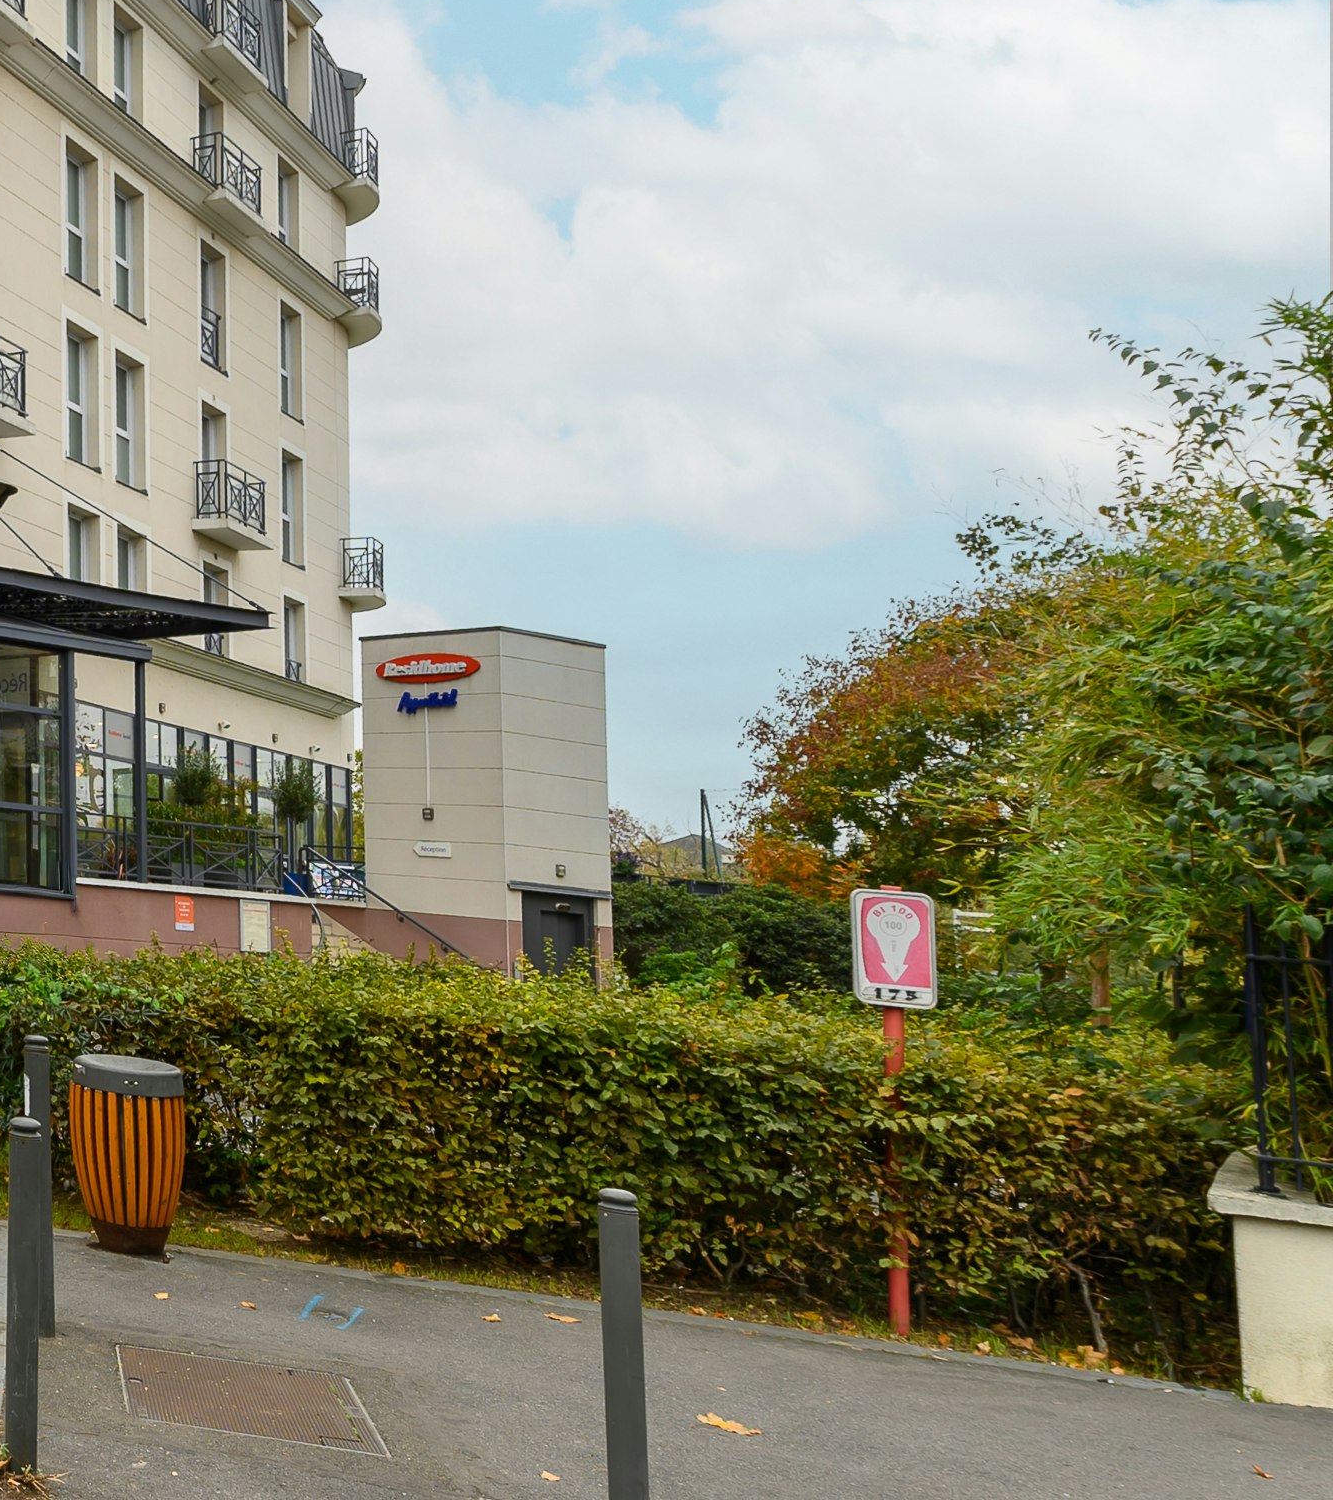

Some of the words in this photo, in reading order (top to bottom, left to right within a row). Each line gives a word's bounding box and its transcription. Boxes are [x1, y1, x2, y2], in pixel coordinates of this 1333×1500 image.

[383, 659, 467, 677] Residhome
[890, 904, 913, 919] 100
[885, 921, 902, 930] 100
